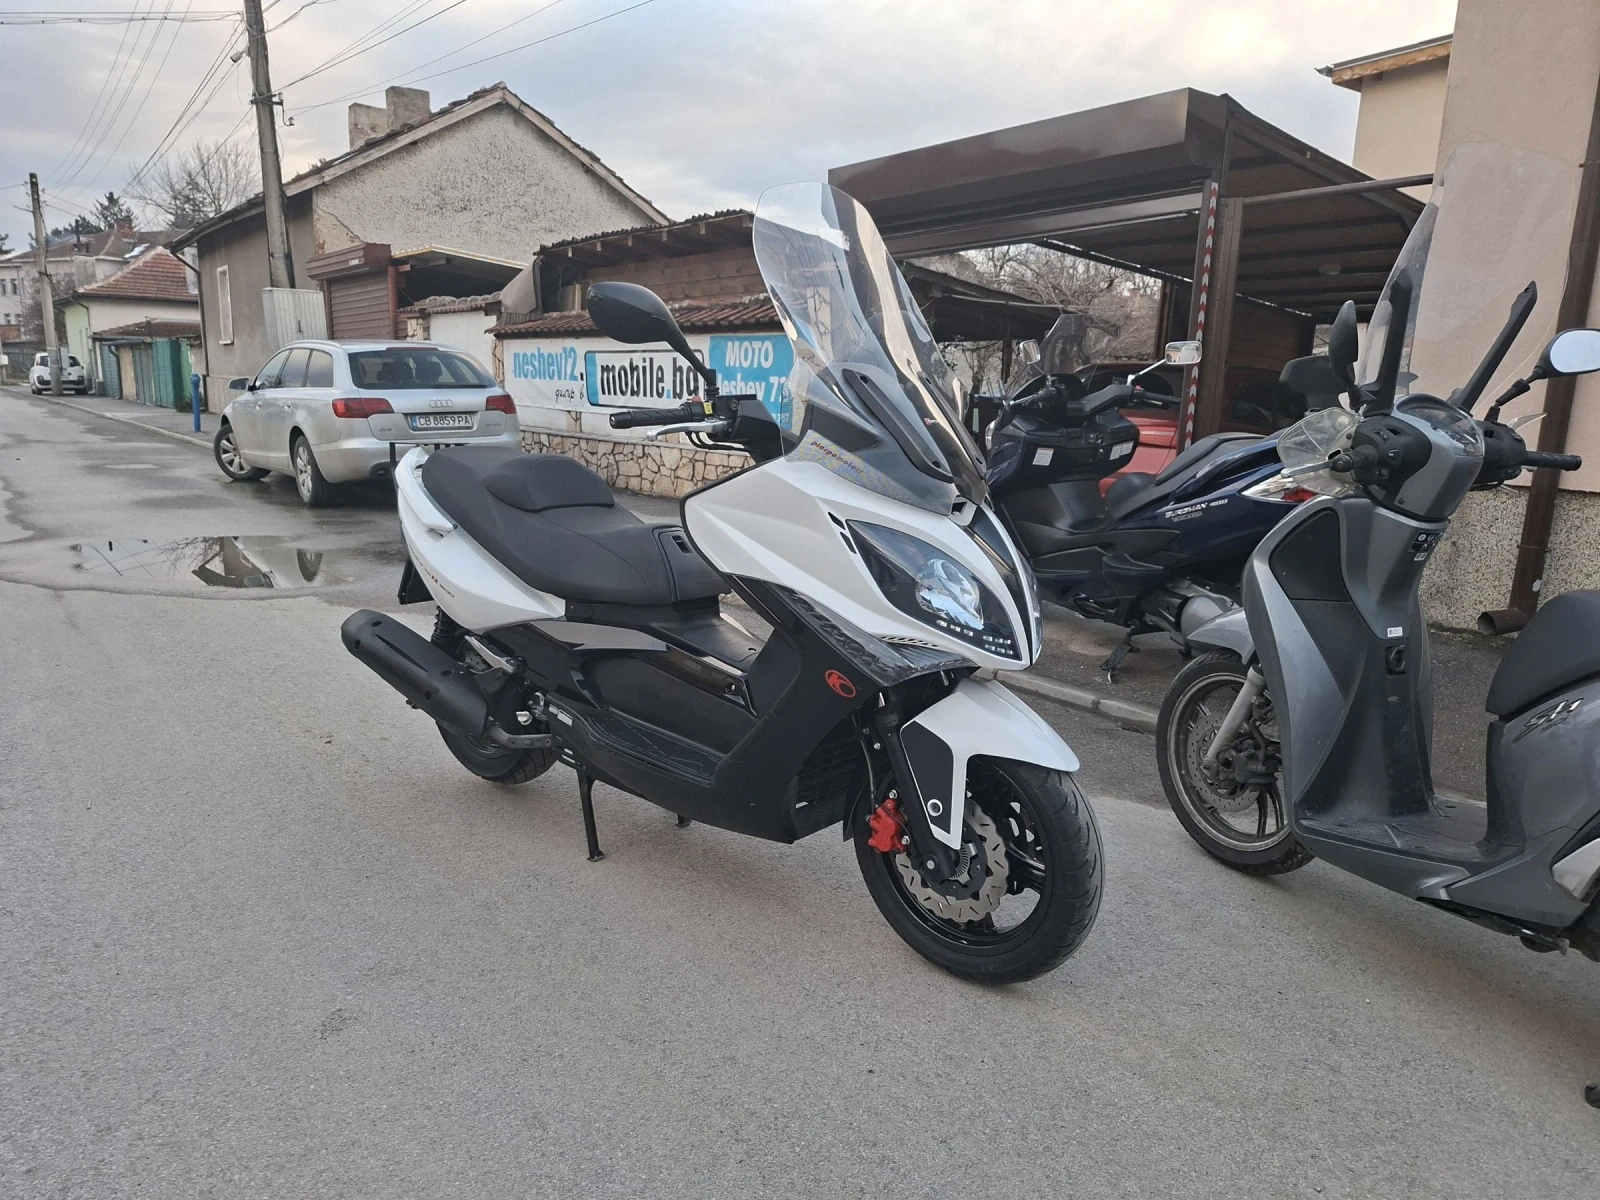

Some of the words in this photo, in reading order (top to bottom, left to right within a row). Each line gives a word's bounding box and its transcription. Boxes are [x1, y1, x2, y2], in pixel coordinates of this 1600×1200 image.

[725, 340, 774, 368] MOTO
[418, 416, 432, 426] CB
[434, 415, 456, 426] 8859
[457, 415, 471, 425] PA
